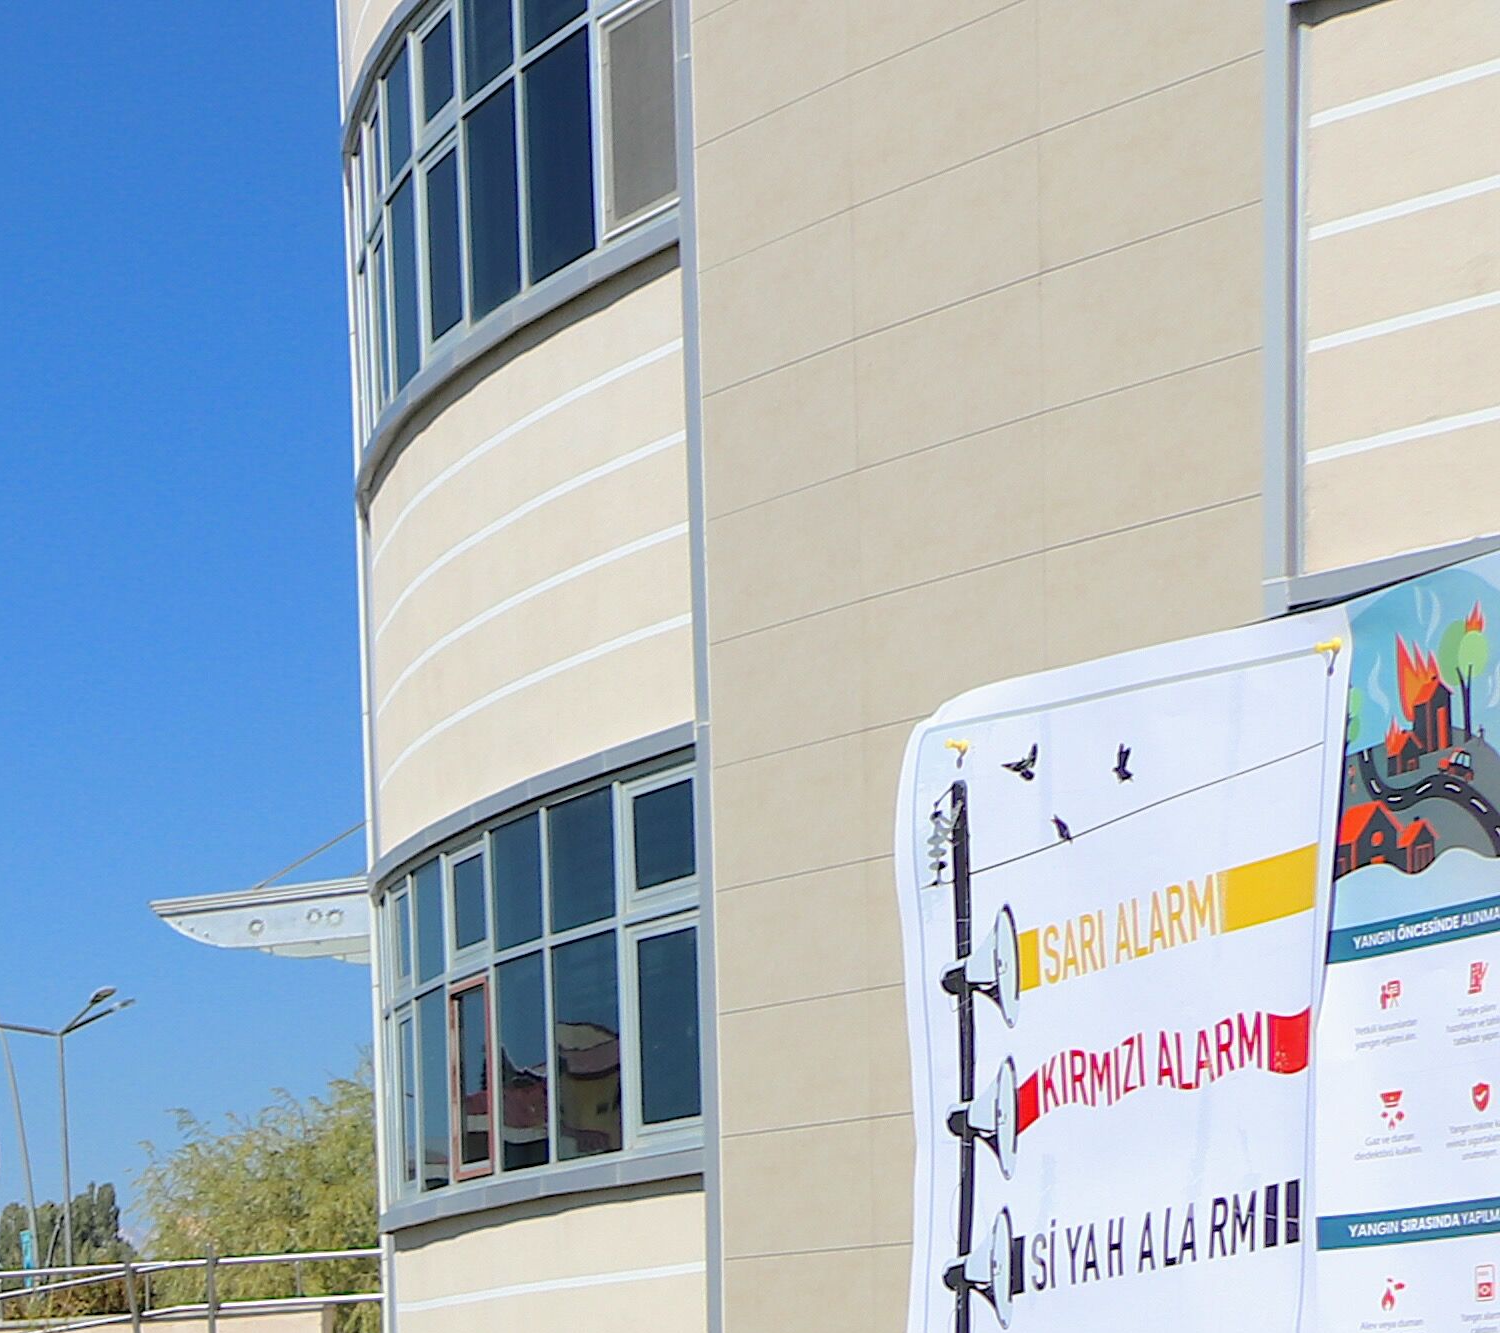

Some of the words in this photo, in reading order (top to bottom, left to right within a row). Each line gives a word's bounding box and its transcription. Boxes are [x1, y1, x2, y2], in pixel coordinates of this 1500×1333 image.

[1043, 909, 1103, 985] SARI
[1114, 874, 1220, 964] ALARM
[1352, 931, 1395, 950] YANGIN
[1397, 917, 1460, 939] ÖNCESİNDE
[1039, 1032, 1146, 1114] KIRMIZI
[1157, 1009, 1264, 1090] ALARM
[1030, 1216, 1127, 1292] SİYAH
[1138, 1189, 1257, 1273] ALARM
[1348, 1221, 1399, 1237] YANGIN
[1402, 1213, 1461, 1232] SIRASINDA
